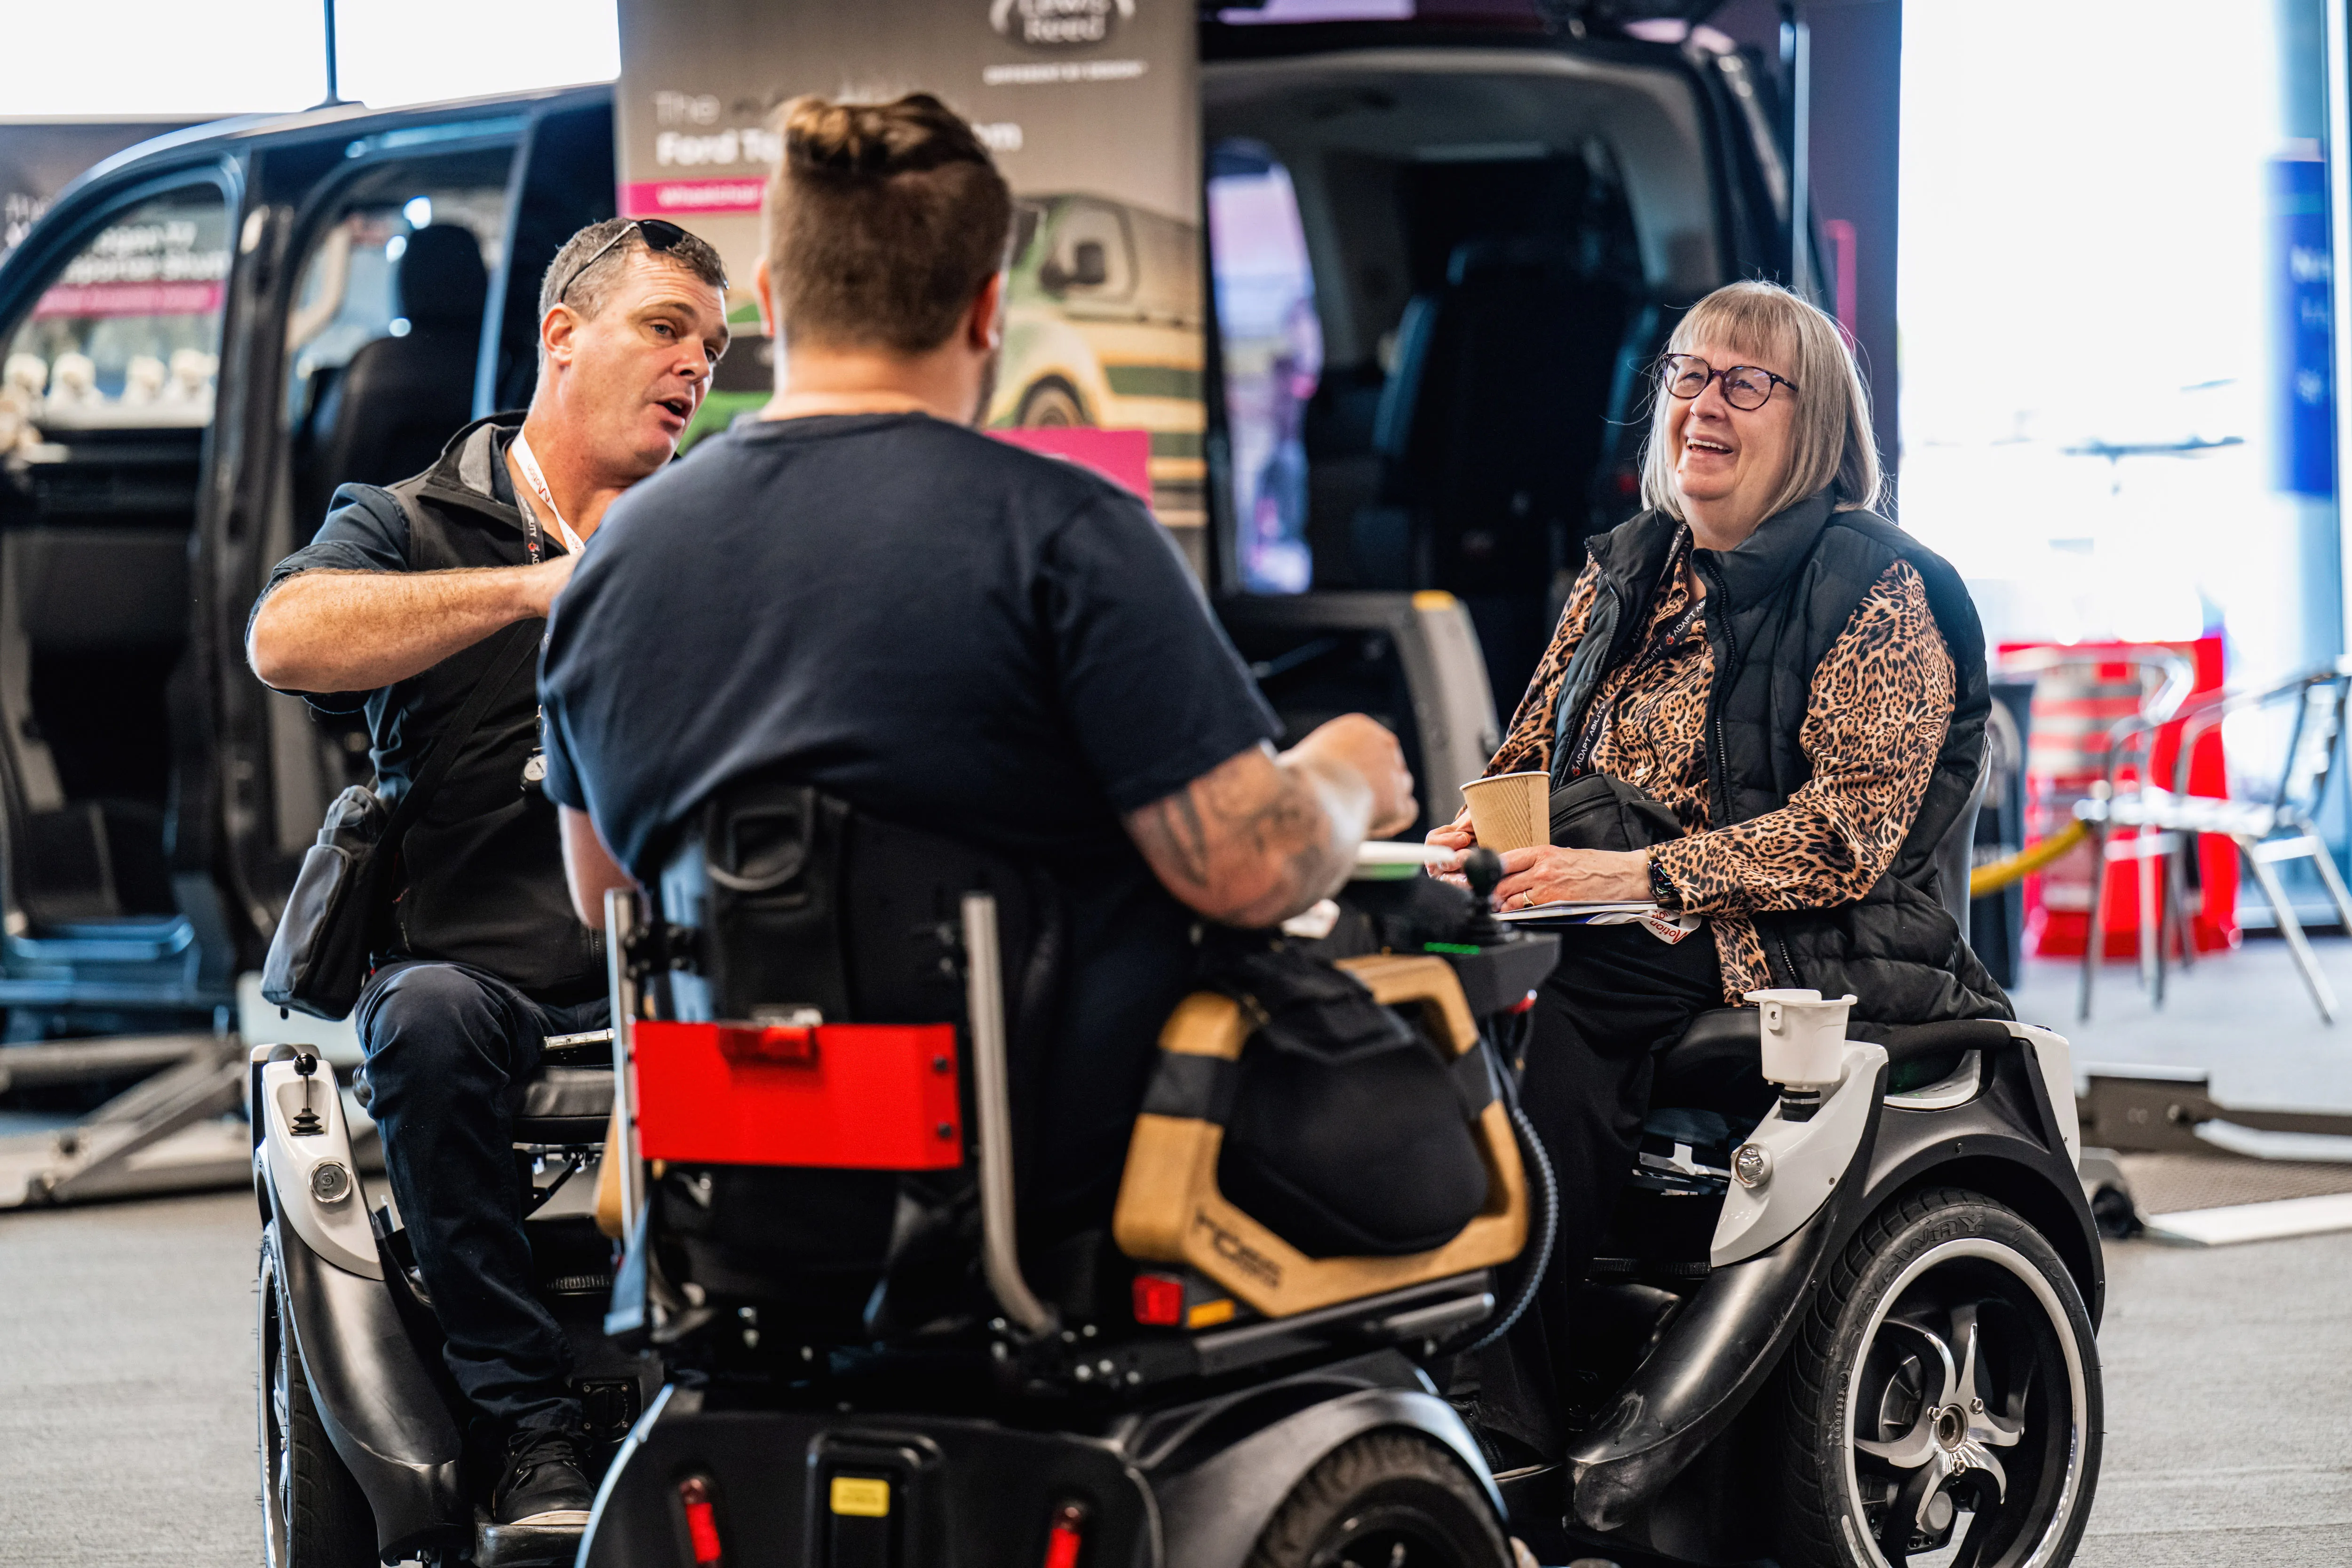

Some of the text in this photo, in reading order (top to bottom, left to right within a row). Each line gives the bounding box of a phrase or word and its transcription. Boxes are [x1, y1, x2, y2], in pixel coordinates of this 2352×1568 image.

[655, 91, 720, 124] The
[657, 130, 739, 165] Ford
[1673, 598, 1706, 636] ADAPT AB
[1639, 644, 1662, 672] ABILITY
[1576, 703, 1606, 766] ADAPT ABILITY
